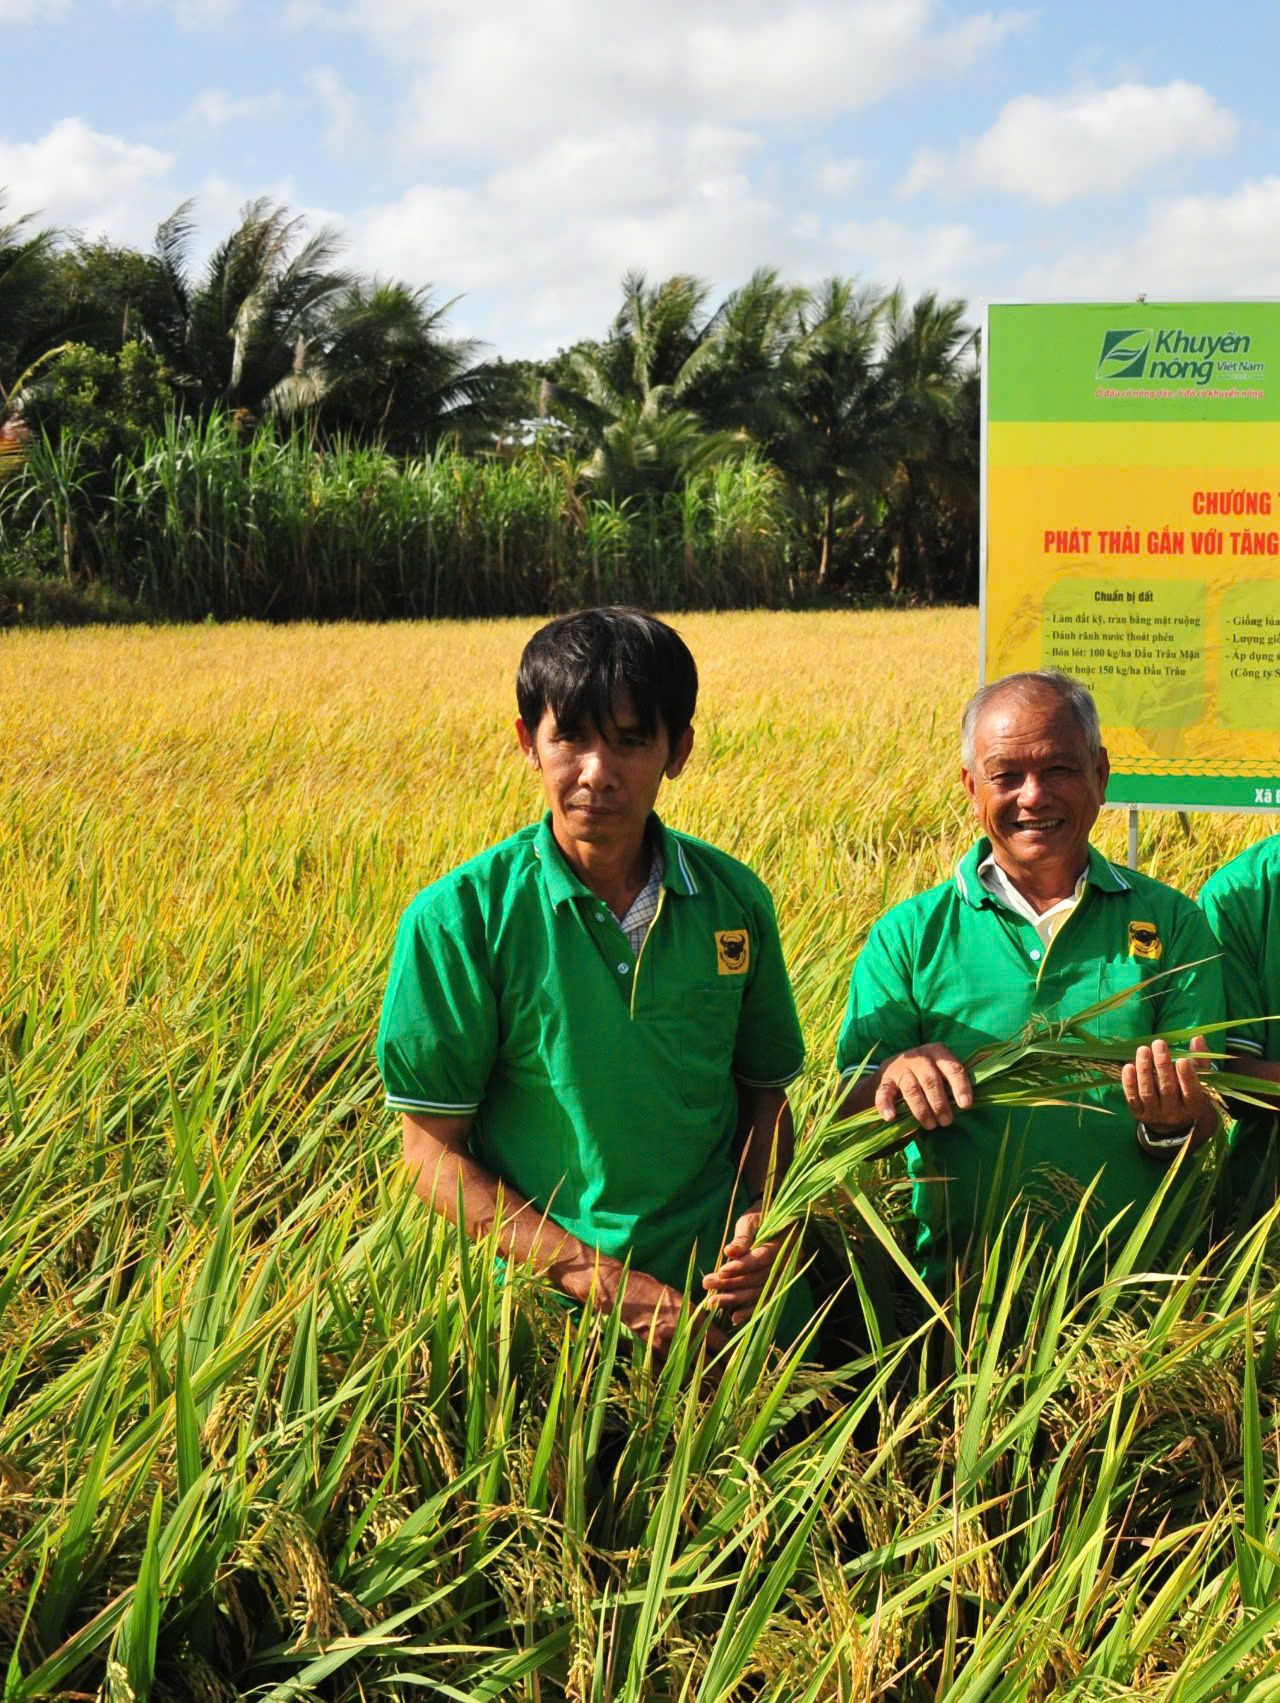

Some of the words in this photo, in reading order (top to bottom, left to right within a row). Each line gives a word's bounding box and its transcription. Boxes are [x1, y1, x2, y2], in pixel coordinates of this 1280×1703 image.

[1150, 358, 1214, 385] nông
[1239, 362, 1264, 371] Nam
[1192, 489, 1271, 515] CHƯƠNG
[1044, 527, 1091, 554] PHÁT
[1098, 525, 1140, 555] THẢI
[1147, 524, 1184, 555] GẮN
[1191, 527, 1222, 555] VỚI
[1230, 528, 1279, 556] TĂNG
[1126, 591, 1136, 604] bị
[1138, 590, 1153, 602] đất
[1233, 613, 1262, 628] Giống
[1266, 617, 1280, 626] lúa
[1233, 634, 1264, 645] Lượng
[1090, 648, 1104, 658] 100
[1107, 648, 1132, 660] kg/ha
[1250, 651, 1274, 662] dụng
[1099, 665, 1113, 674] 150
[1116, 665, 1140, 677] kg/ha
[1264, 669, 1272, 680] ty
[1255, 788, 1272, 803] Xã
